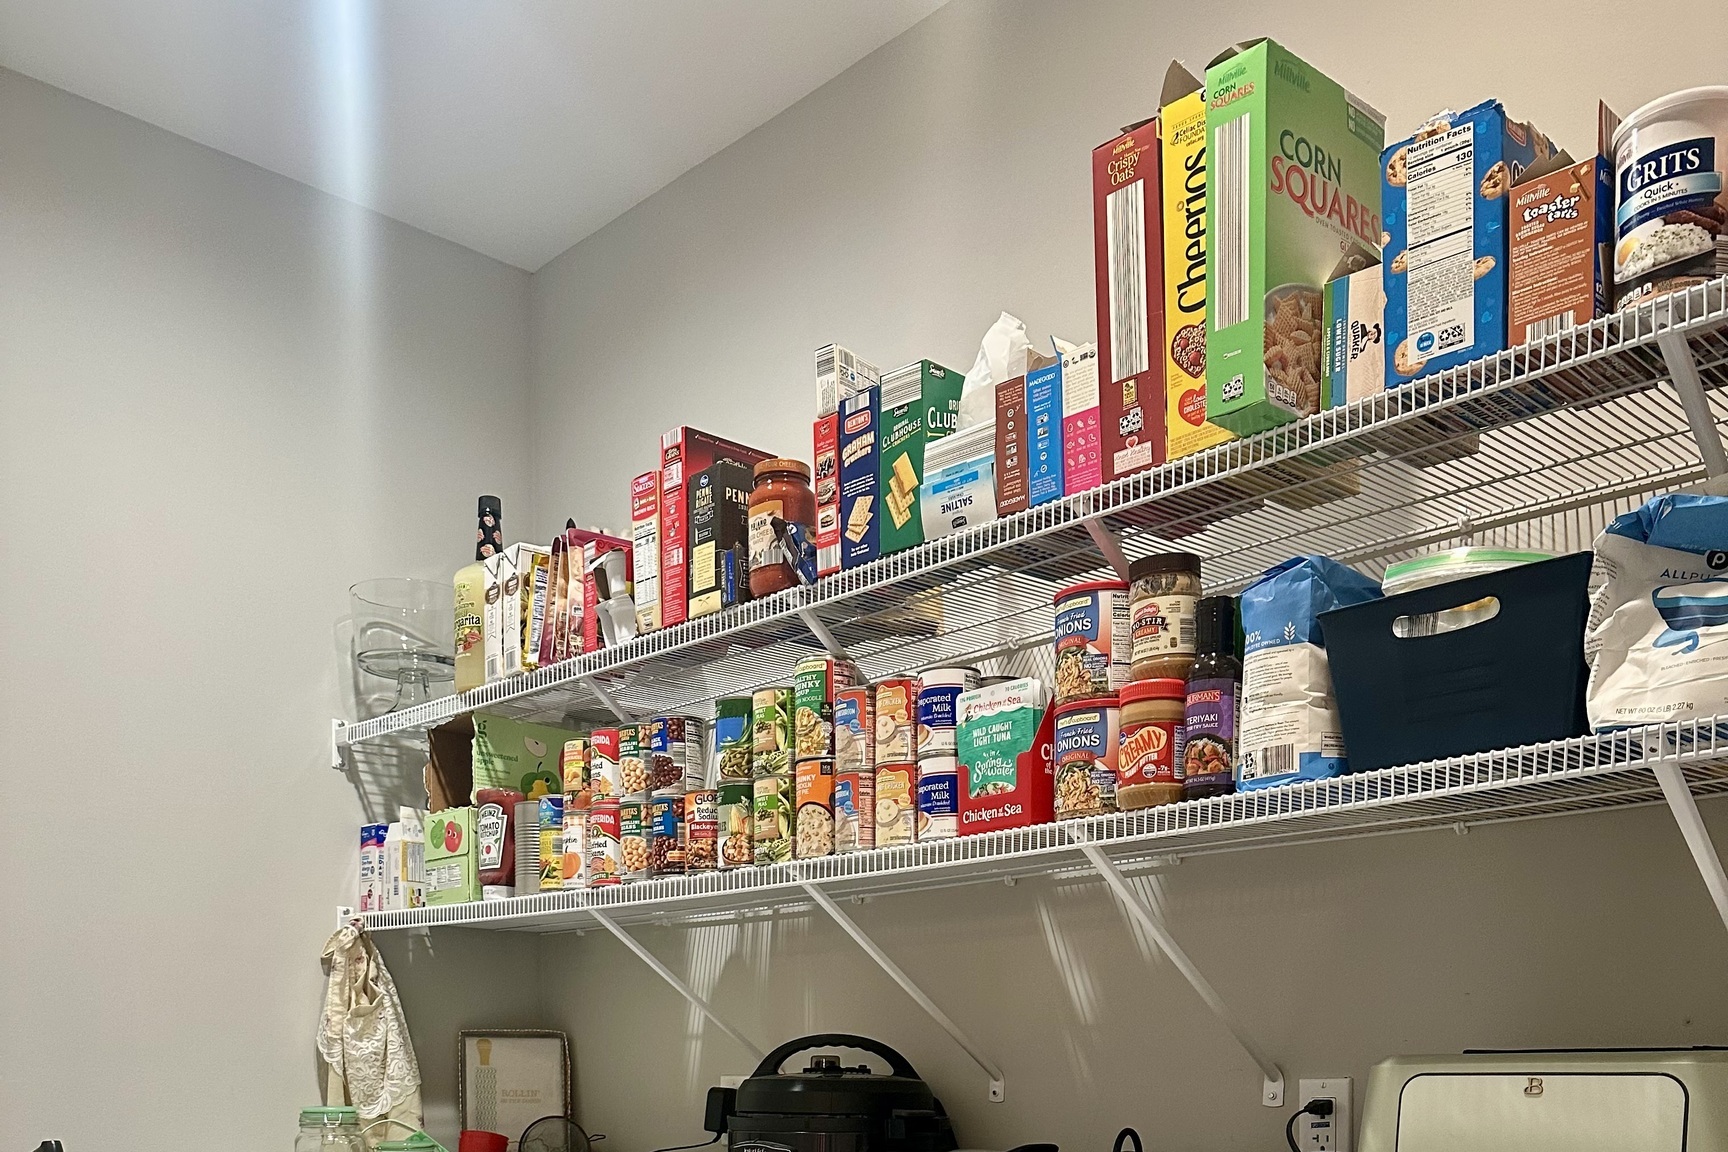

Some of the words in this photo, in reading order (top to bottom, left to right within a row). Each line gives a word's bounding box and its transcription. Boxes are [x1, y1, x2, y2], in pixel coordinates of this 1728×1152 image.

[1218, 63, 1247, 86] Millville
[1274, 60, 1310, 92] Millville
[1210, 82, 1254, 110] SQUARES
[1213, 82, 1236, 99] CORN
[1113, 137, 1134, 155] Millville
[1408, 136, 1444, 154] Nutrition
[1446, 126, 1471, 138] Facts
[1108, 152, 1140, 175] Crispy
[1280, 129, 1342, 187] CORN
[1455, 150, 1472, 162] 130
[1112, 167, 1134, 186] Oats
[1408, 166, 1436, 180] Calories
[1627, 147, 1700, 192] GRITS
[1516, 185, 1551, 208] Millville
[1644, 181, 1673, 199] Quick
[1271, 156, 1380, 243] SQUARES
[1522, 193, 1581, 222] toaster
[1633, 200, 1650, 212] COOKS
[1662, 188, 1688, 199] MINUTES
[1547, 206, 1578, 222] tarts
[1350, 320, 1359, 360] QUAKER
[1029, 373, 1055, 387] MADEGOOD
[882, 418, 921, 448] CLUBHOUSE
[894, 418, 909, 431] ORIGINAL
[842, 431, 875, 460] GRAHAM
[696, 485, 712, 499] PENNE
[696, 496, 713, 509] RIGATE
[941, 496, 973, 514] SALTINE
[1070, 610, 1085, 620] Fried
[1133, 618, 1162, 631] NO-STIR
[1136, 627, 1155, 636] CREAMY
[1058, 638, 1082, 649] ORIGINAL
[1660, 662, 1683, 671] BLEACHED
[882, 698, 902, 707] CHICKEN
[974, 700, 1002, 714] Chicken
[1008, 696, 1022, 705] Sea
[1187, 691, 1220, 706] BURMAN'S
[1672, 703, 1685, 711] 2.27
[1686, 702, 1694, 710] kg
[932, 704, 951, 712] Milk
[1187, 713, 1218, 725] TERIYAKI
[972, 726, 986, 738] WILD
[988, 721, 1012, 733] CAUGHT
[1077, 727, 1093, 735] Fried
[974, 736, 992, 748] LIGHT
[993, 730, 1011, 742] TUNA
[1057, 734, 1100, 752] ONIONS
[1062, 752, 1089, 762] ORIGINAL
[1120, 730, 1162, 769] CREAMY
[1139, 752, 1158, 767] BUTTER
[973, 758, 1002, 783] Spring
[884, 783, 905, 791] CHICKEN
[931, 791, 950, 800] Milk
[481, 808, 497, 818] HEINZ
[963, 808, 997, 824] Chicken
[1004, 803, 1022, 816] Sea
[480, 822, 500, 830] TOMATO
[480, 830, 499, 838] KETCHUP
